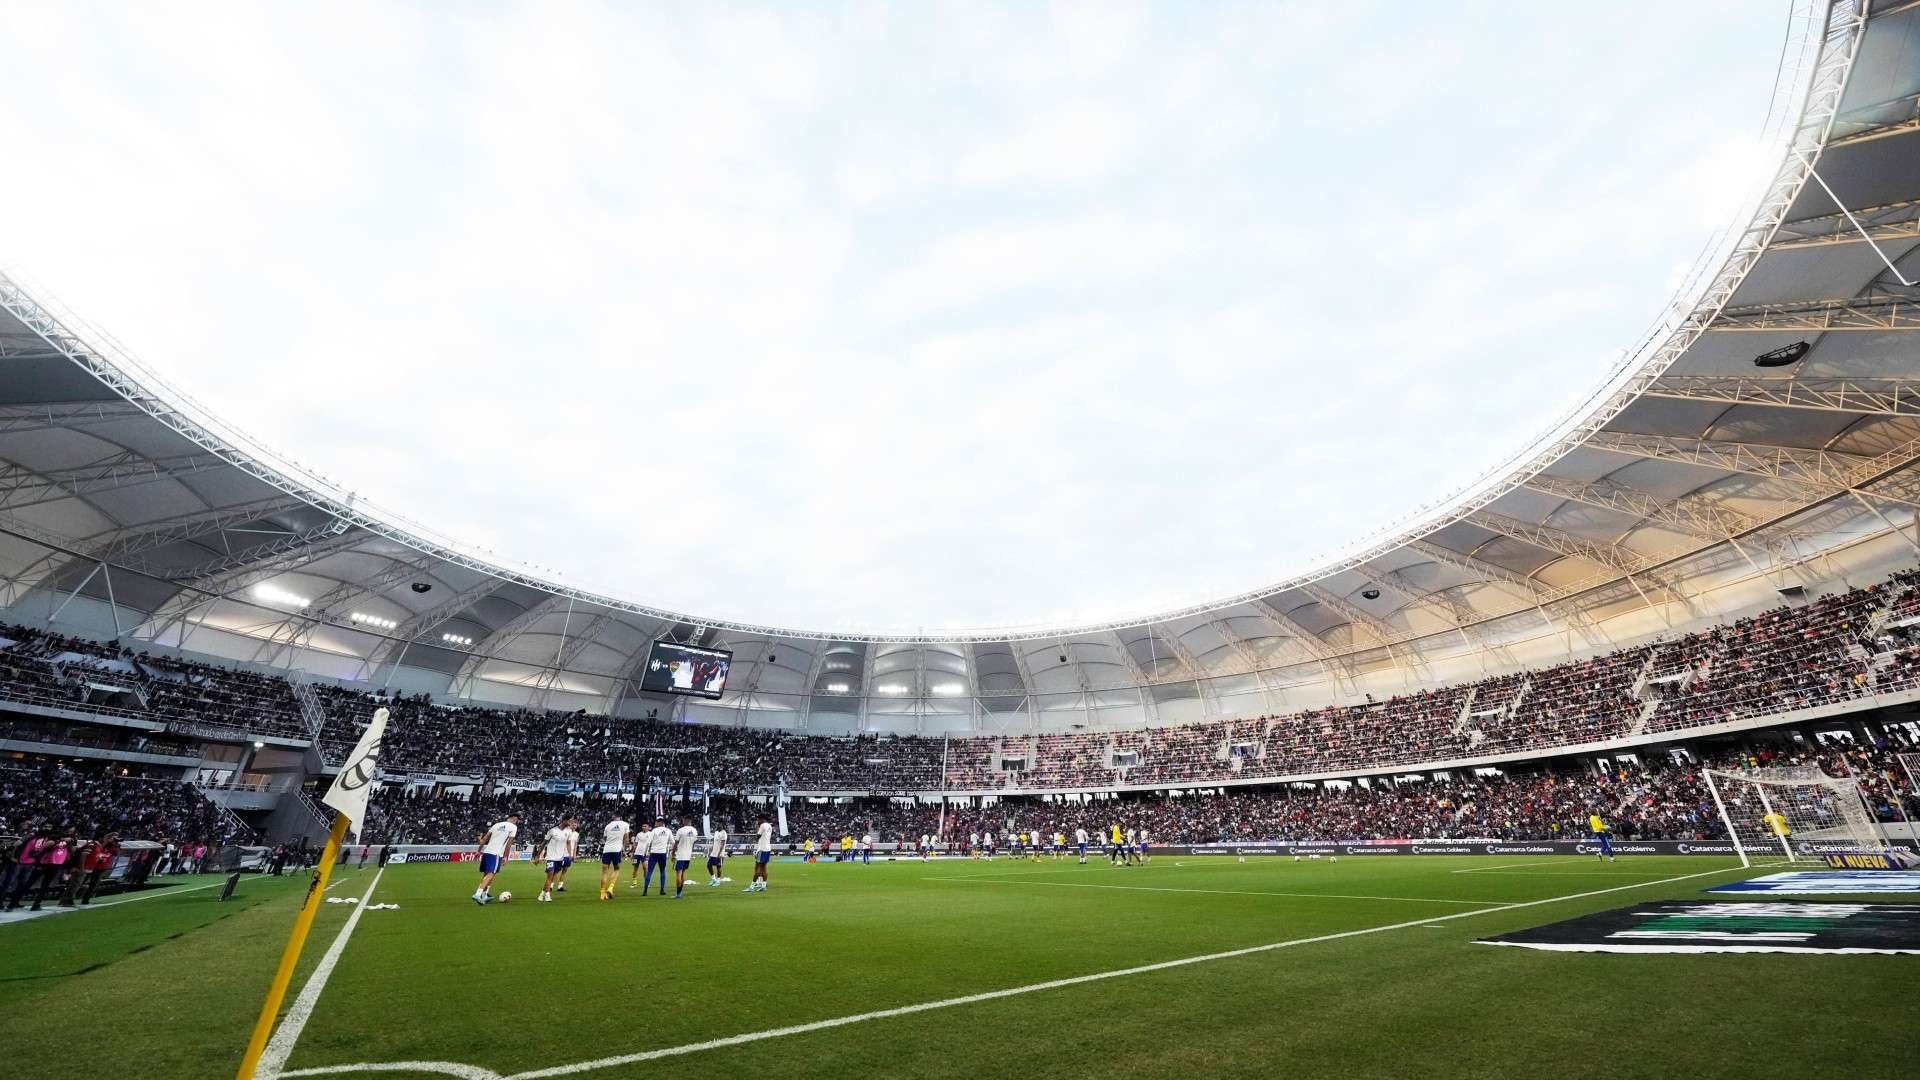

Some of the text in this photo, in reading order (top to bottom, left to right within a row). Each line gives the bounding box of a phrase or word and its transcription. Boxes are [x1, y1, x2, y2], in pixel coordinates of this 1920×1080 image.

[1526, 845, 1554, 853] Gobierno
[1826, 855, 1890, 868] LA NUEVA
